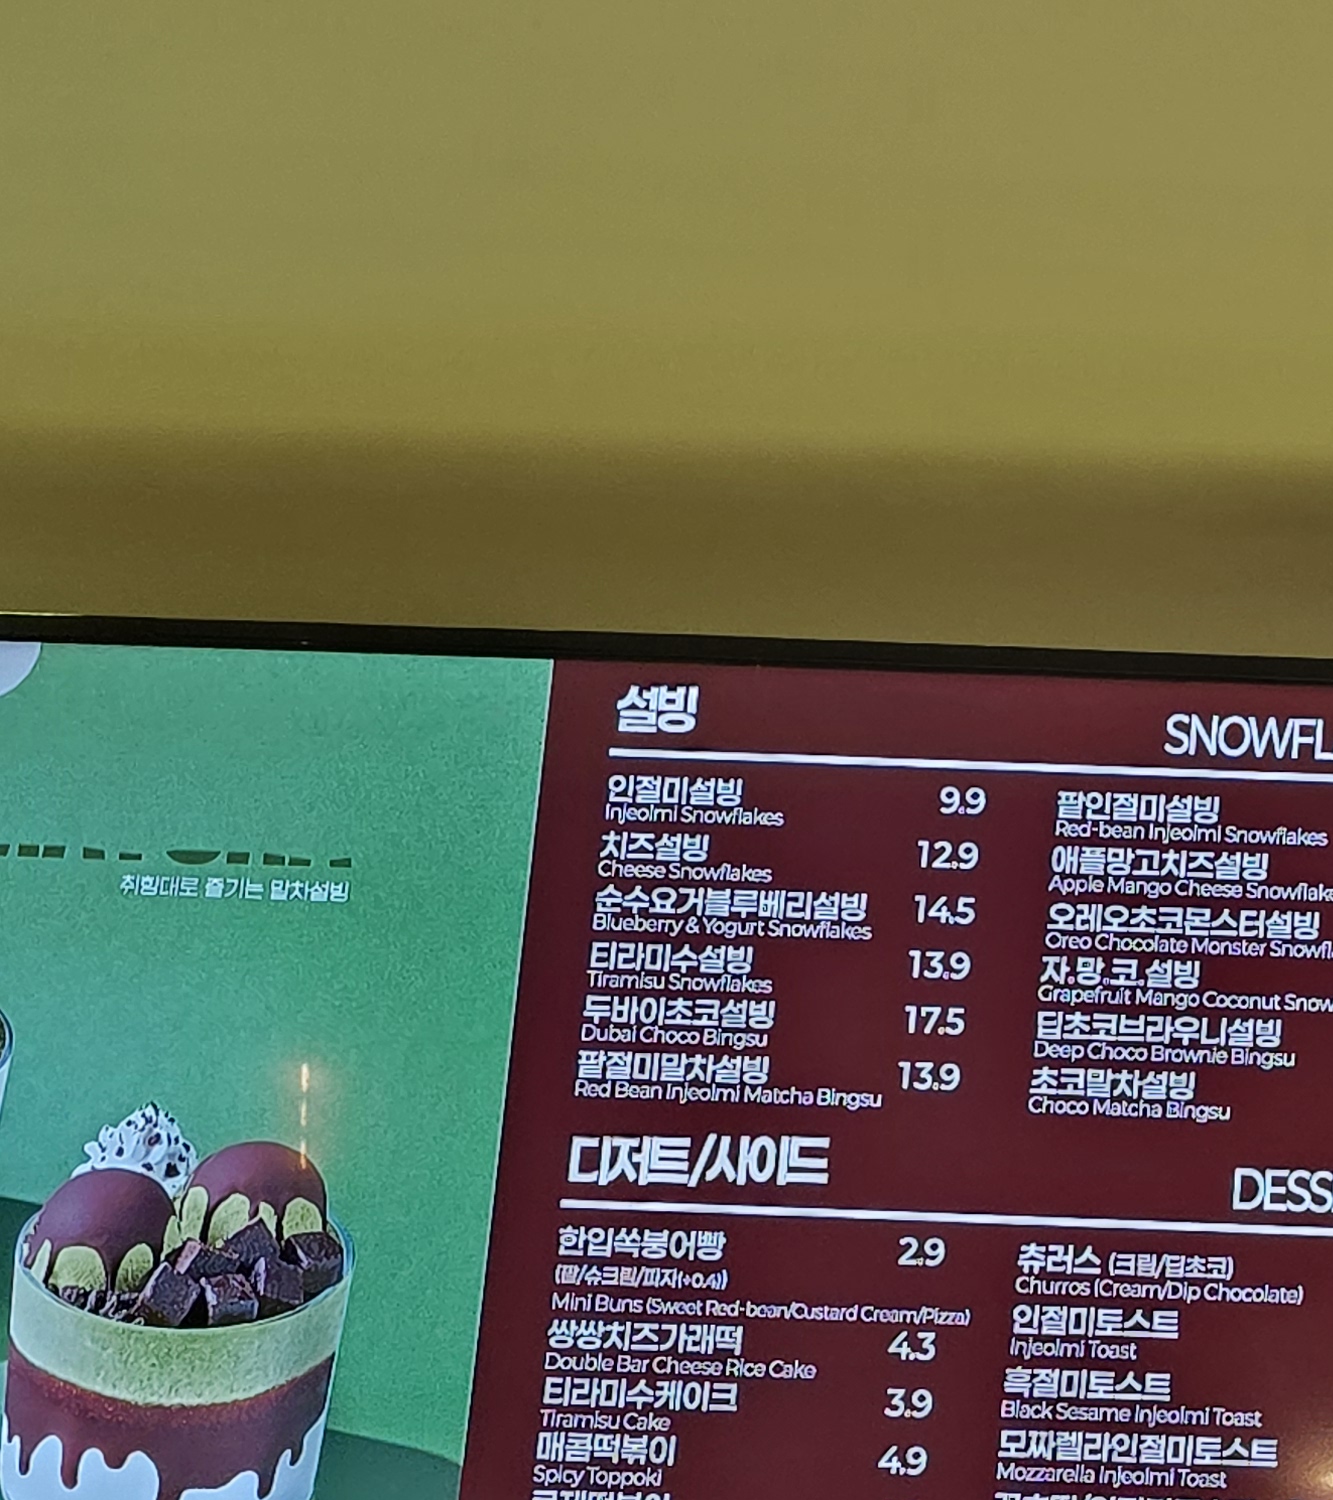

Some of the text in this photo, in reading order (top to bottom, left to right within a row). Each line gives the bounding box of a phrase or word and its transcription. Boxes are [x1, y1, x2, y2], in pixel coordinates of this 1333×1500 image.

[616, 684, 699, 733] 설빙
[608, 774, 743, 807] 인절미설빙
[939, 785, 986, 815] 9.9
[599, 829, 710, 862] 치즈설빙
[917, 839, 979, 870] 12.9
[1051, 845, 1269, 881] 애플망고치즈설빙
[597, 858, 773, 883] Cheese Snowflakes
[120, 875, 349, 902] 취향대로 즐기는 말차설빙
[594, 883, 868, 922] 순수요거블루베리설빙
[914, 894, 976, 925] 14.5
[1046, 902, 1320, 940] 오레오초코몬스터설빙
[589, 940, 753, 975] 티라미수설빙
[908, 949, 971, 980] 13.9
[582, 994, 776, 1030] 두바이초코설빙
[904, 1004, 965, 1036] 17.5
[1036, 1010, 1282, 1048] 딥초코브라우니설빙
[1033, 1039, 1296, 1071] Deep Choco Brownie Bingsu
[897, 1060, 960, 1091] 13.9
[1028, 1065, 1196, 1101] 초코말차설빙
[567, 1132, 830, 1188] 디저트/사이드
[557, 1224, 727, 1261] 한입쏙붕어빵
[897, 1236, 945, 1267] 2.9
[546, 1318, 744, 1356] 쌍쌍치즈가래떡
[1012, 1303, 1179, 1339] 인절미토스트
[886, 1330, 936, 1361] 4.3
[542, 1375, 738, 1412] 티라미수케이크
[1003, 1365, 1171, 1402] 흑절미토스트
[883, 1387, 933, 1419] 3.9
[535, 1430, 677, 1467] 매콤떡볶이
[877, 1445, 928, 1476] 4.9
[997, 1429, 1278, 1468] 모짜렐라인절미토스트
